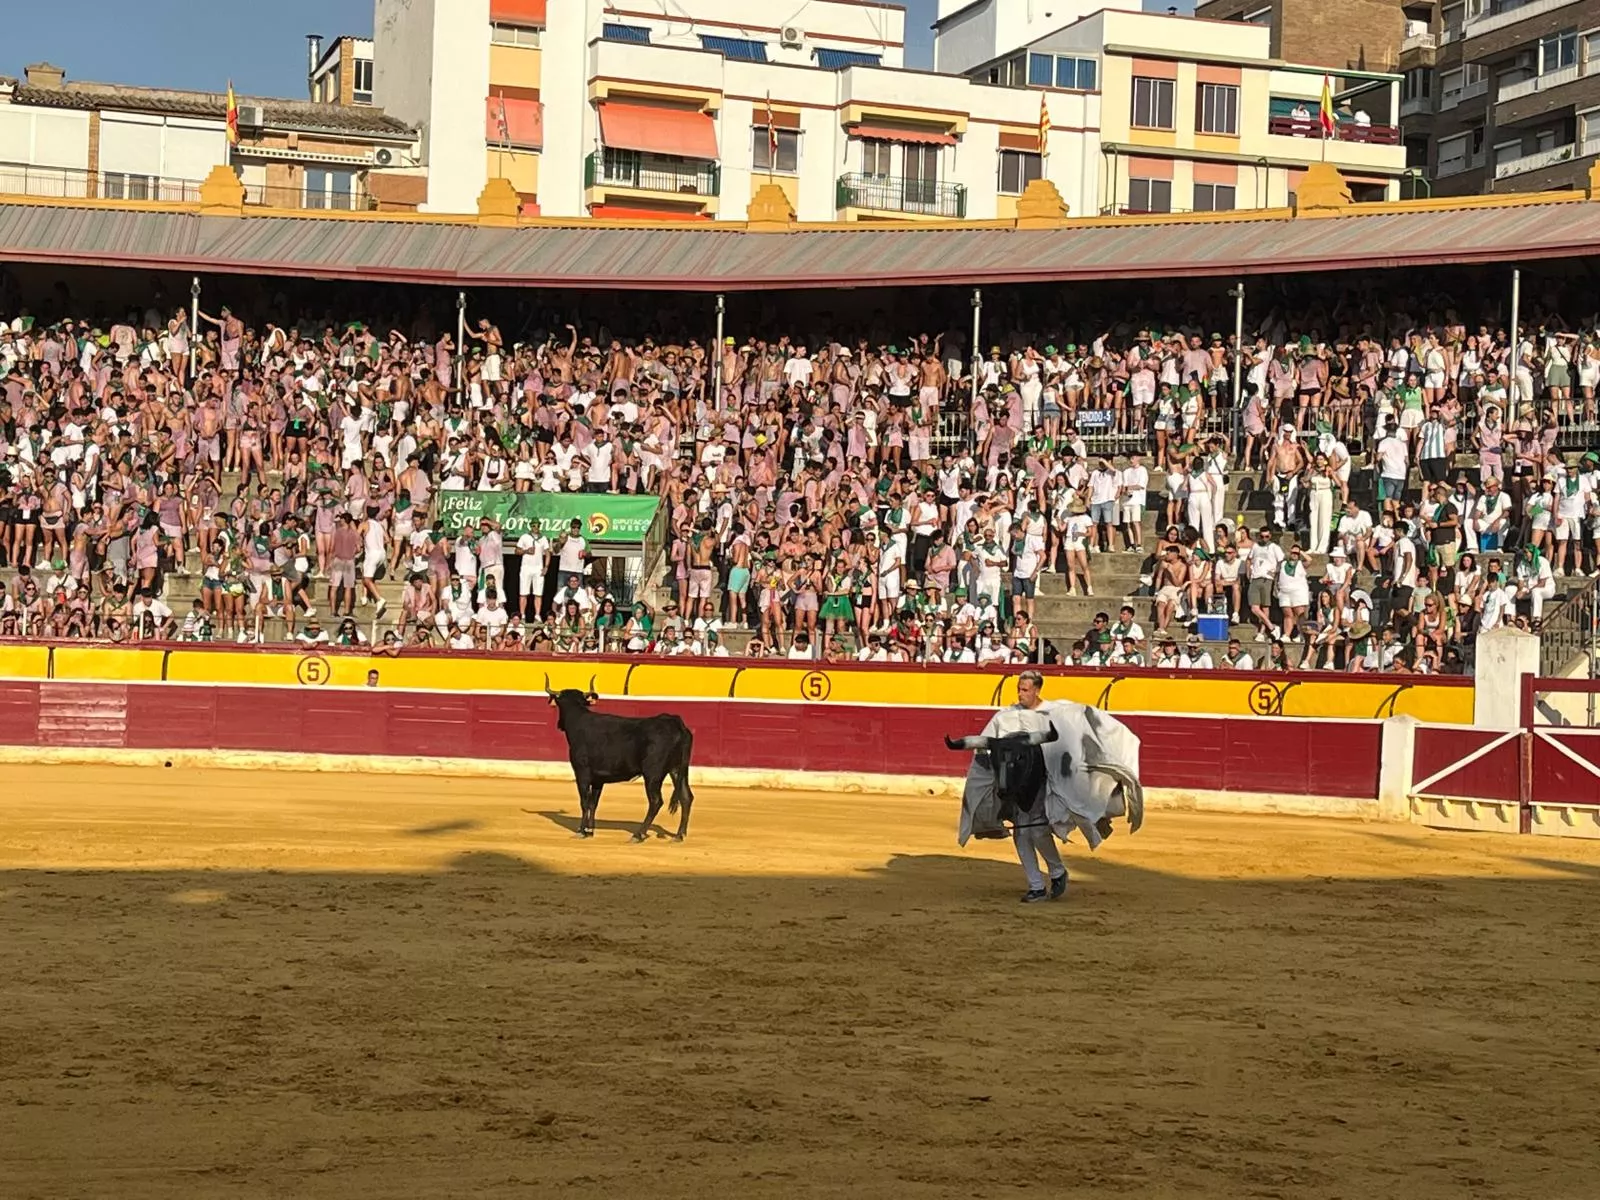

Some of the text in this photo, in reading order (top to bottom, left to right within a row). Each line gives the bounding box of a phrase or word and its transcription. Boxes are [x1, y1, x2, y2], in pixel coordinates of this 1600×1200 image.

[307, 662, 320, 682] 5
[810, 676, 823, 698] 5
[1258, 687, 1272, 710] 5
